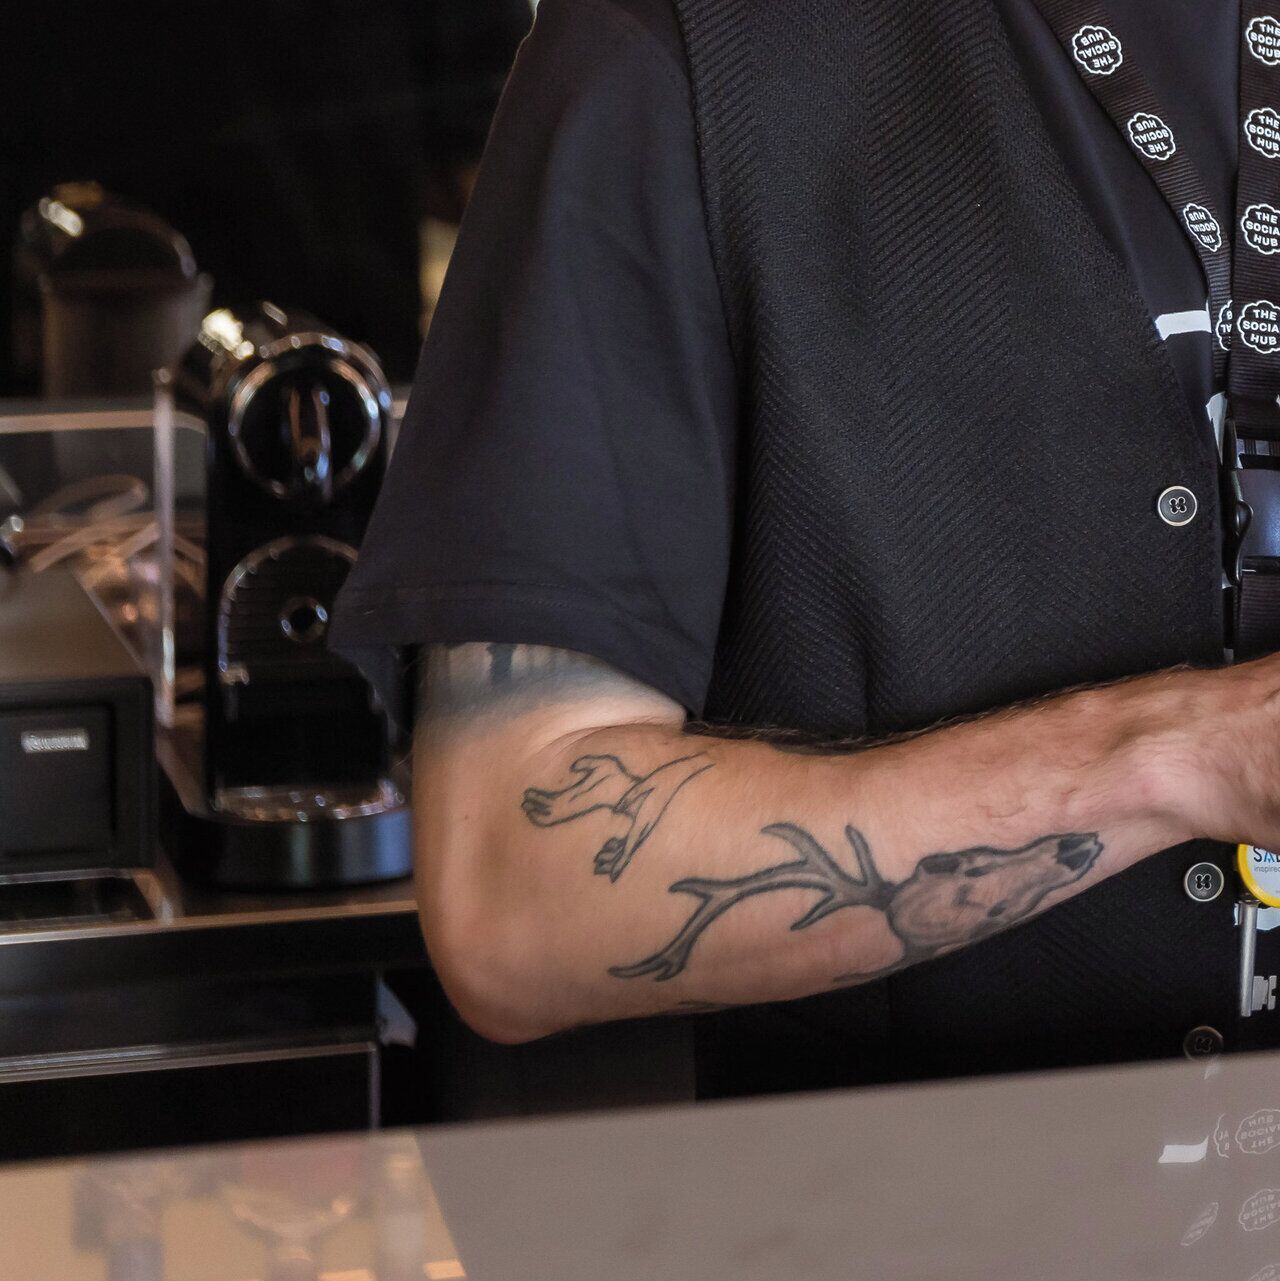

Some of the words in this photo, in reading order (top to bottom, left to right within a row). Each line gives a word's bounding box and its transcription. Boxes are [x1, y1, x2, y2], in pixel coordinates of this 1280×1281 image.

[1080, 31, 1104, 46] HUB
[1078, 40, 1117, 59] SOCIAL
[1092, 54, 1115, 68] THE
[1135, 120, 1157, 131] HUB
[1258, 115, 1280, 129] THE
[1134, 129, 1169, 143] SOCIAL
[1147, 141, 1168, 153] THE
[1257, 137, 1280, 151] HUB
[1255, 211, 1278, 224] THE
[1254, 234, 1278, 247] HUB
[1252, 309, 1277, 321] THE
[1250, 333, 1277, 345] HUB
